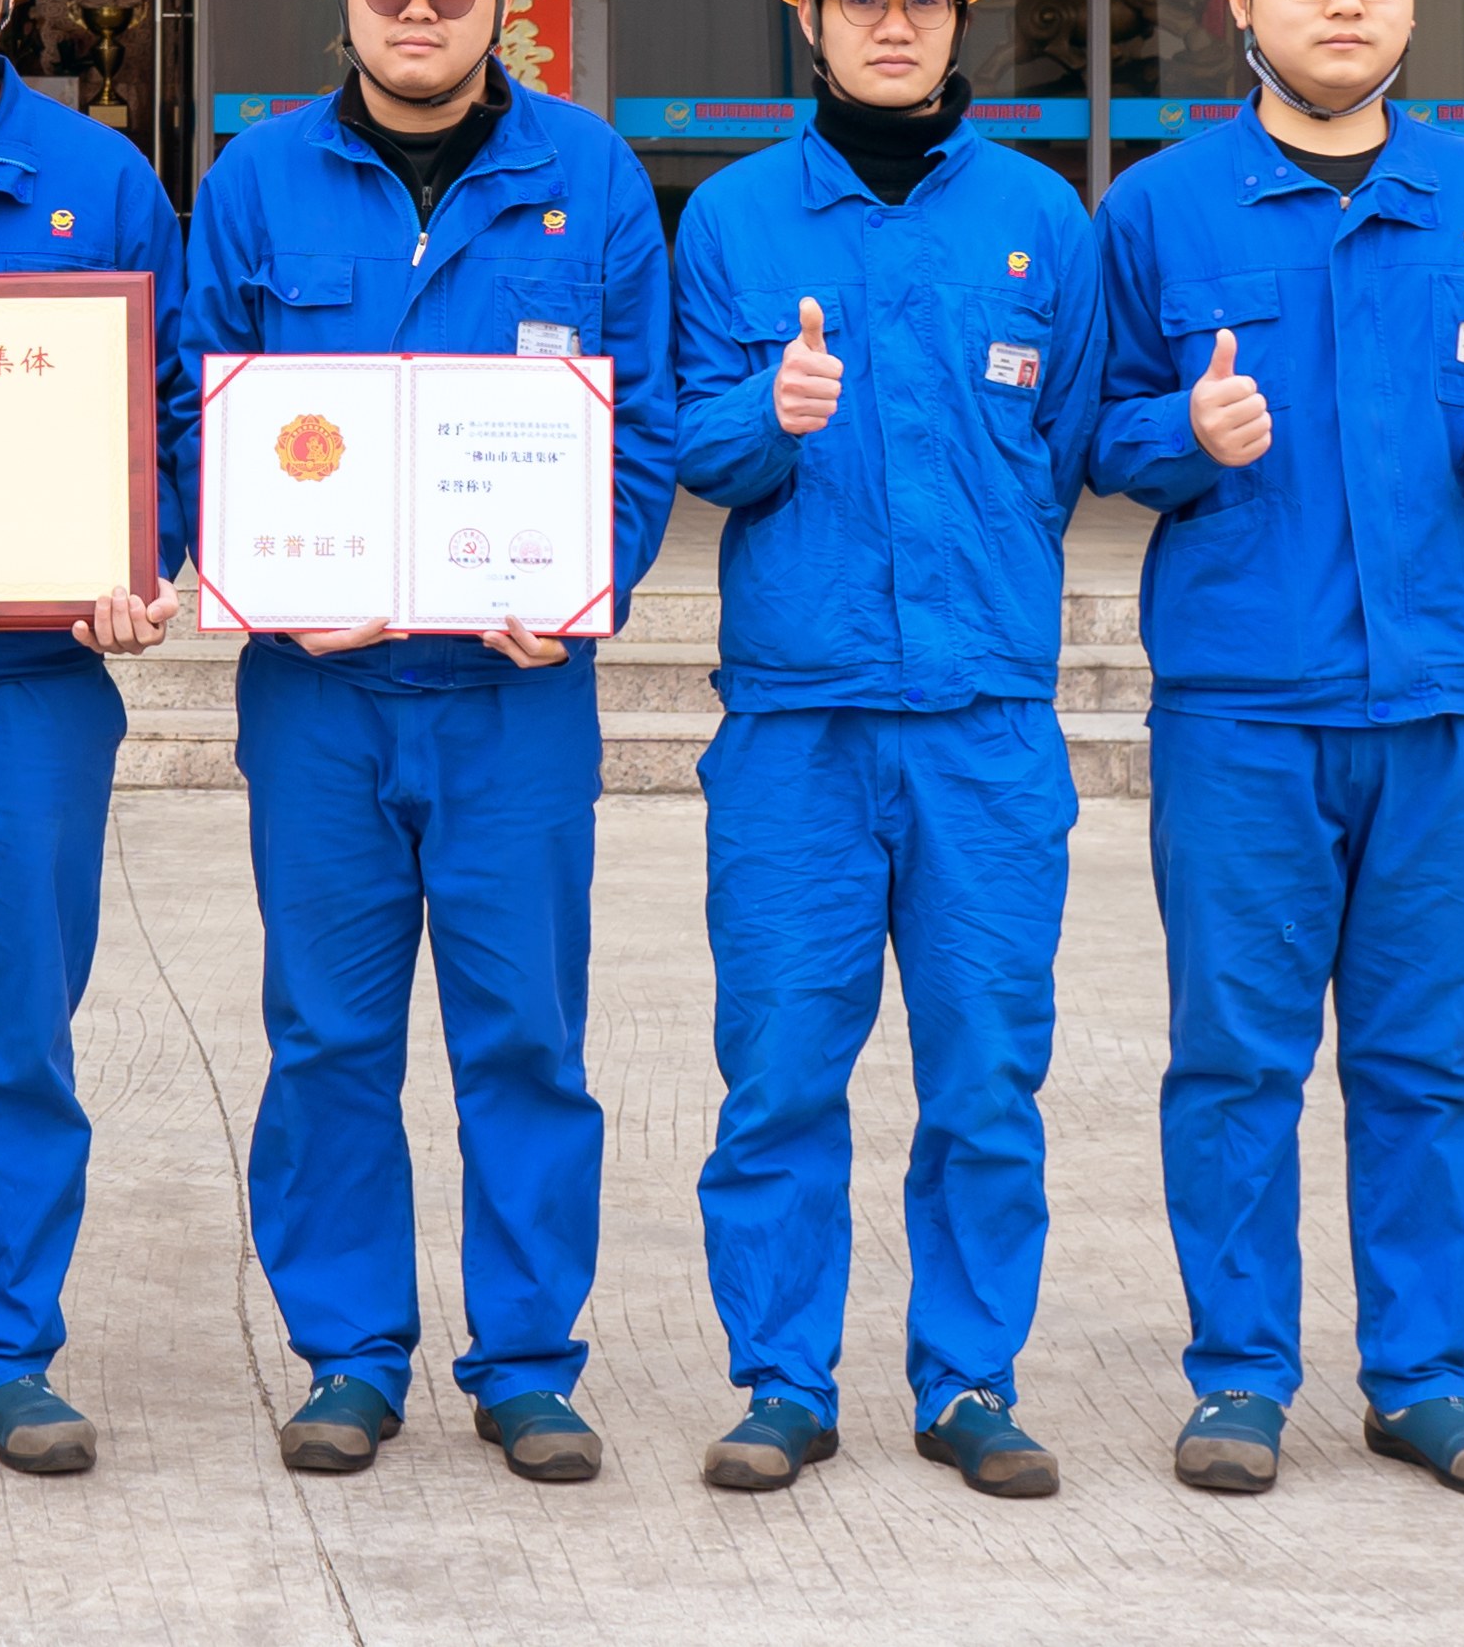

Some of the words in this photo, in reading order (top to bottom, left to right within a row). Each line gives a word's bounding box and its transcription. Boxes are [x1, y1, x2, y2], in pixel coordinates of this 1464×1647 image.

[437, 422, 465, 437] 授予
[436, 479, 493, 494] 荣誉称号
[253, 535, 366, 558] 荣誉证书
